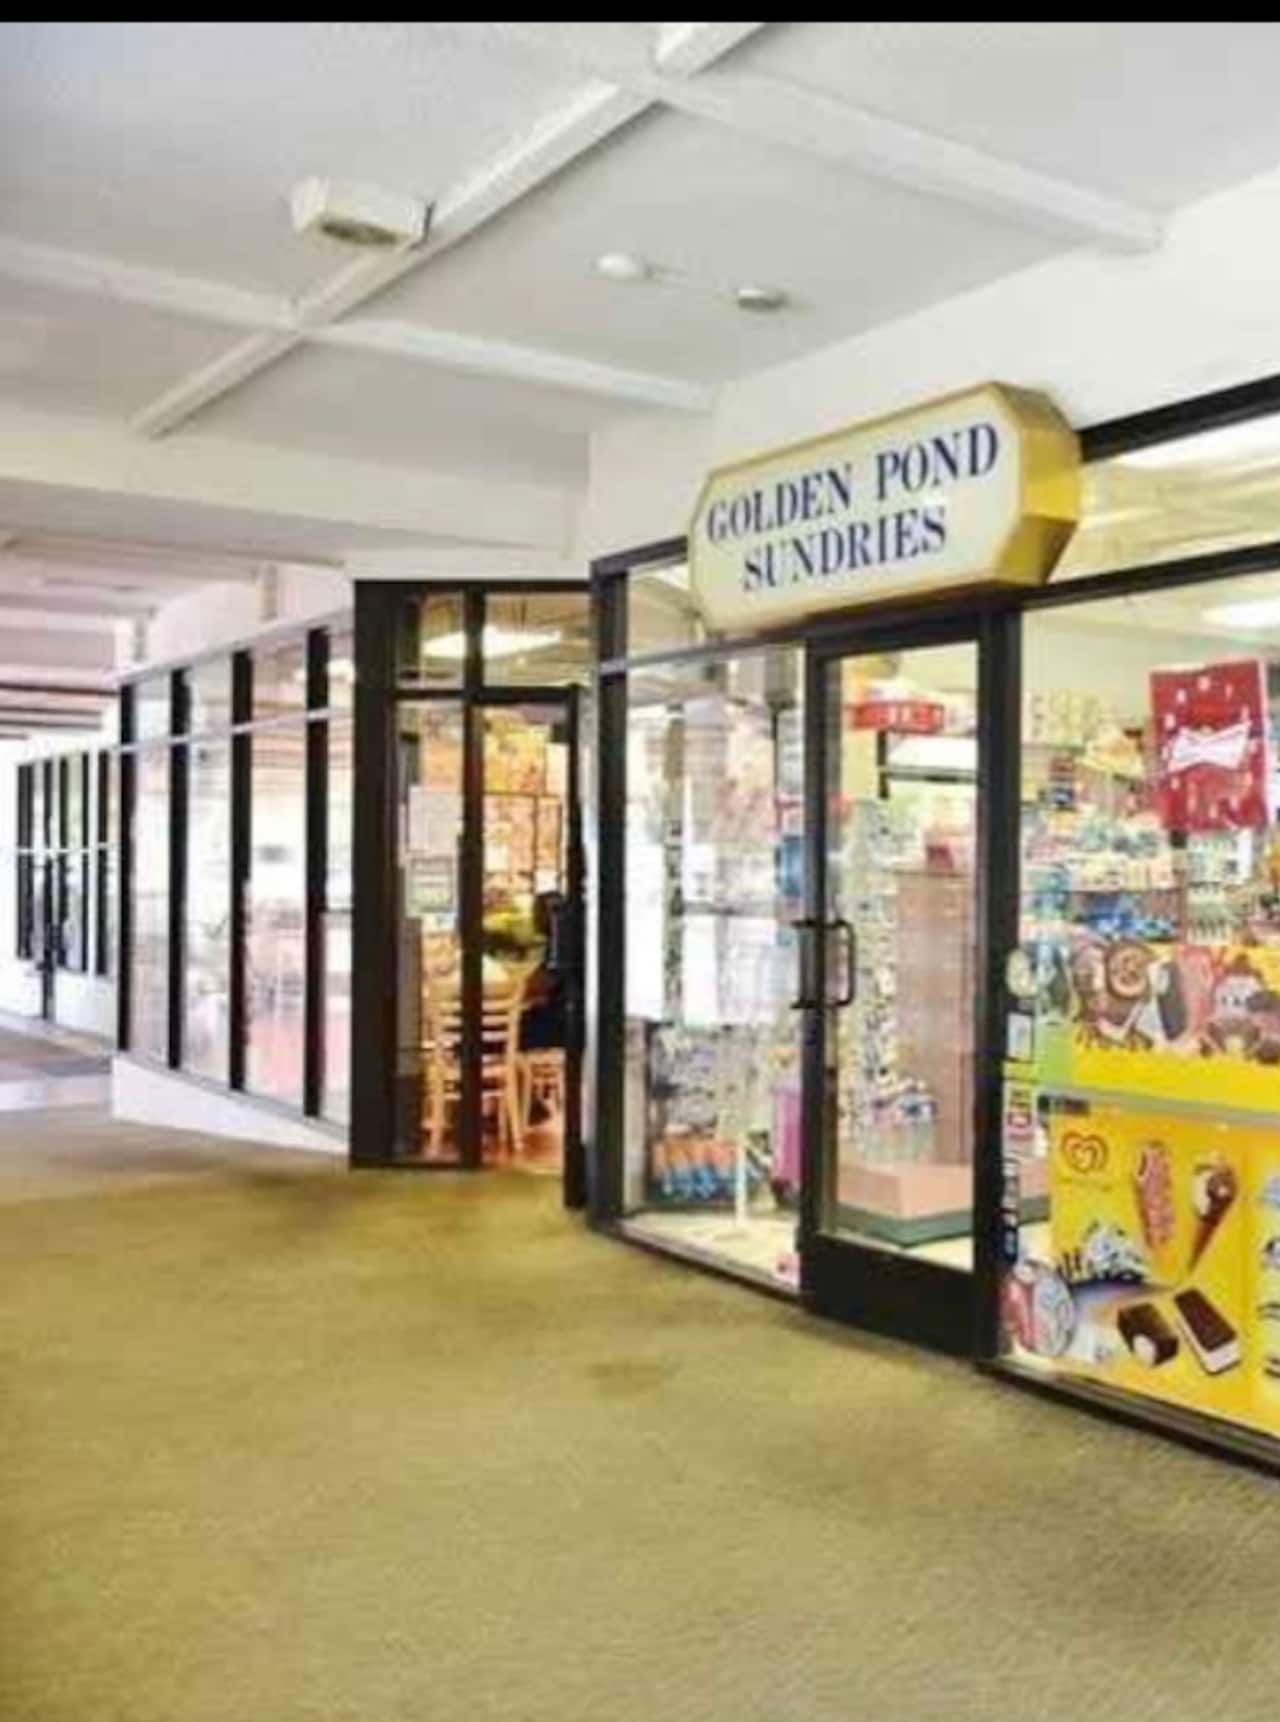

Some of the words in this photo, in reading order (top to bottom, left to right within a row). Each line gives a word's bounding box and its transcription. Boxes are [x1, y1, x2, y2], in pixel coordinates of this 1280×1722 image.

[706, 463, 854, 545] GOLDEN
[876, 422, 999, 501] POND
[742, 507, 947, 593] SUNDRIES
